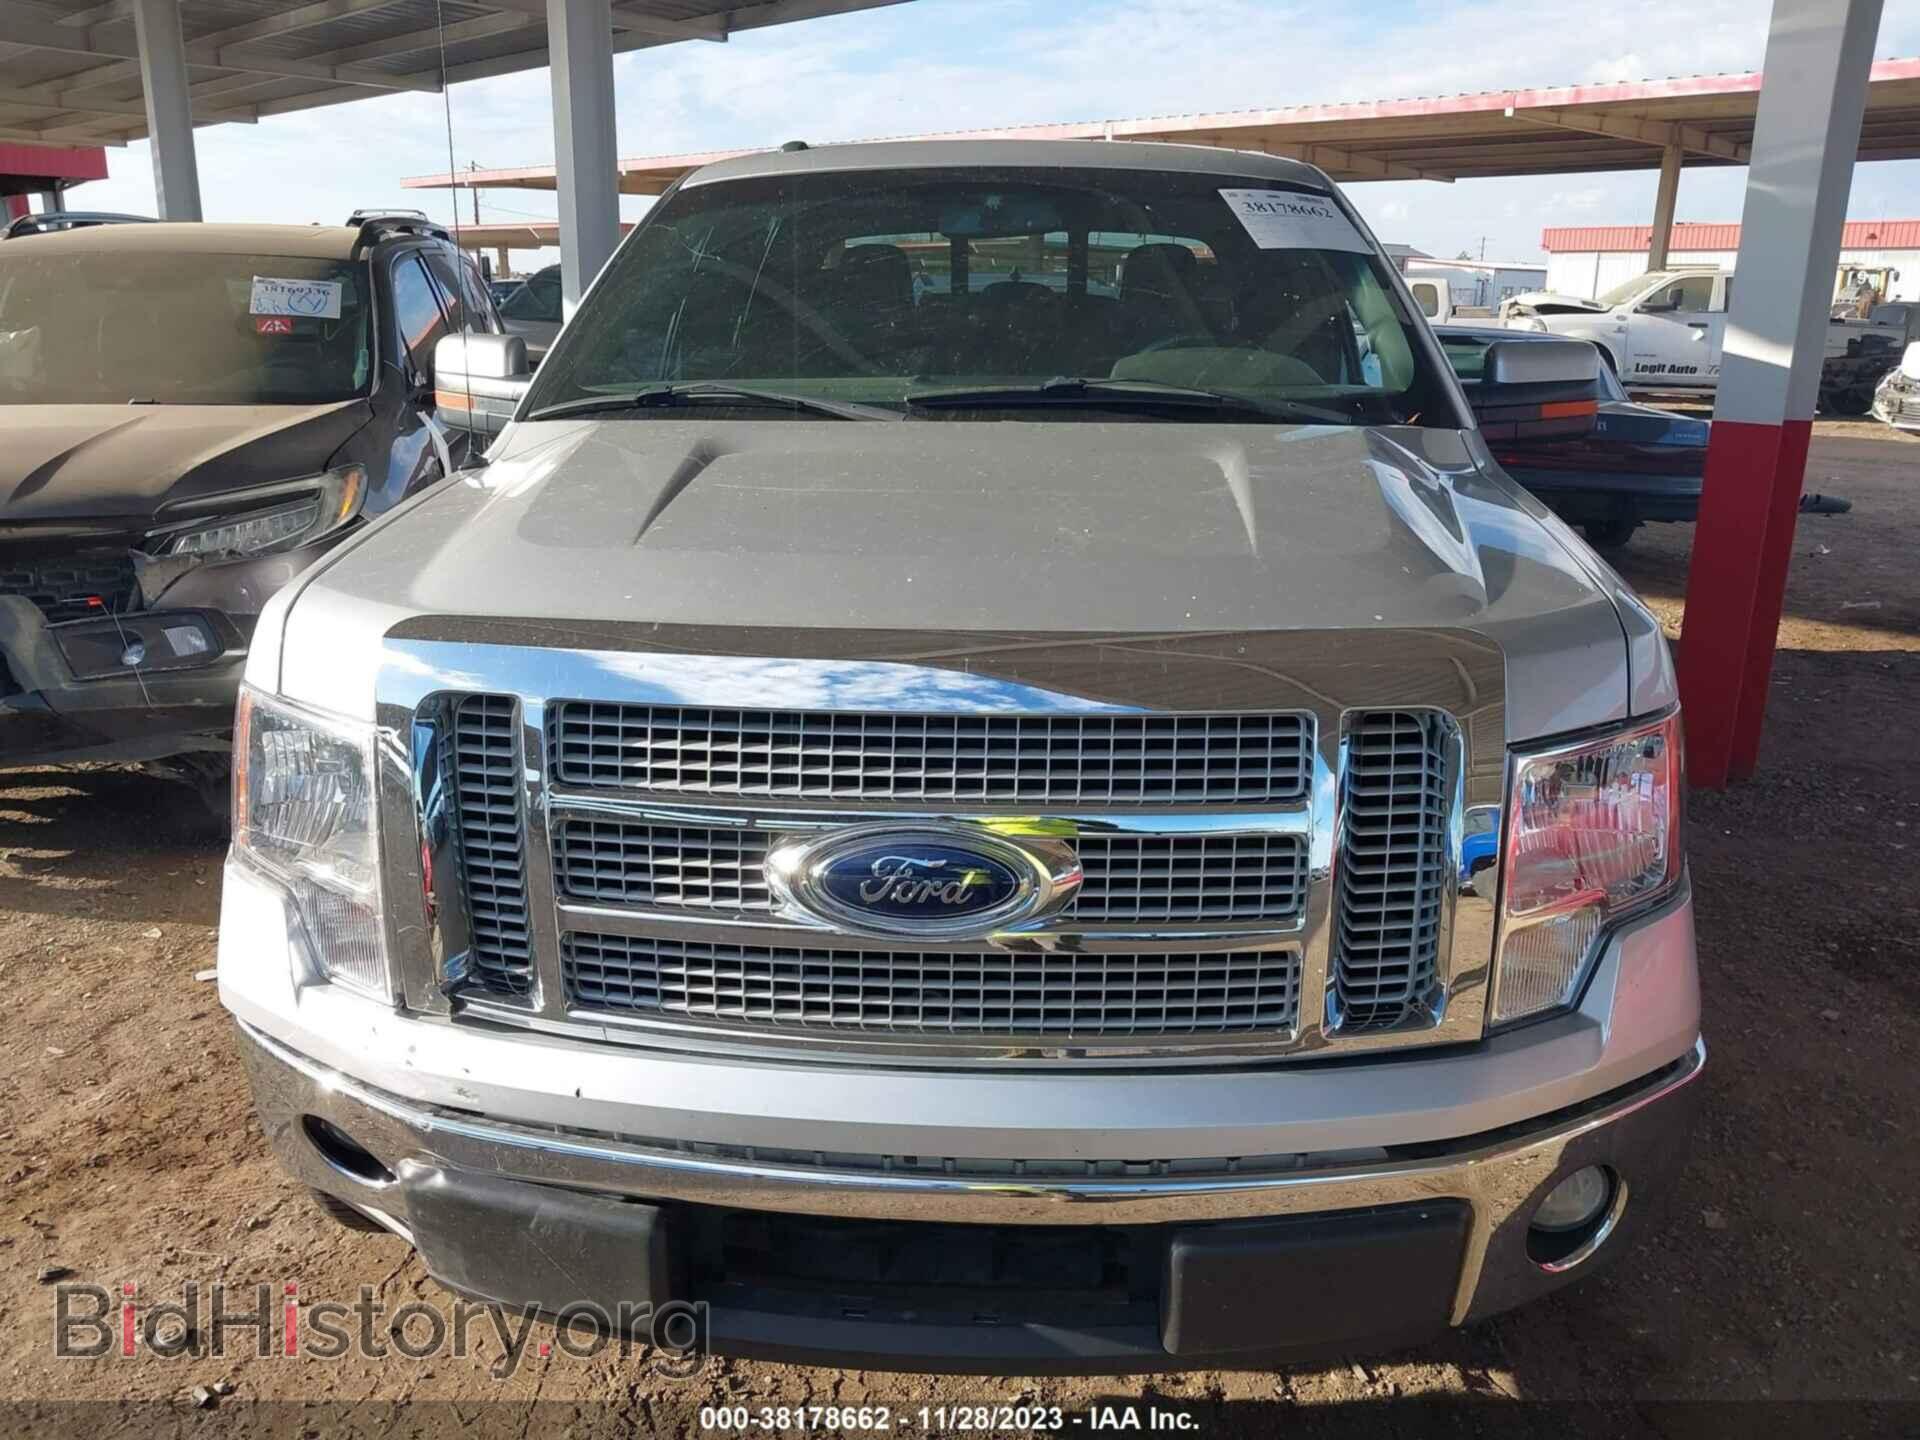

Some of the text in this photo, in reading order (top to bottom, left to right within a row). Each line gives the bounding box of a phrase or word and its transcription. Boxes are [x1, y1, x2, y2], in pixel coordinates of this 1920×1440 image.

[1242, 202, 1333, 218] 38178662
[1634, 363, 1666, 375] Legit
[1667, 364, 1698, 375] Auto
[859, 855, 974, 905] Ford
